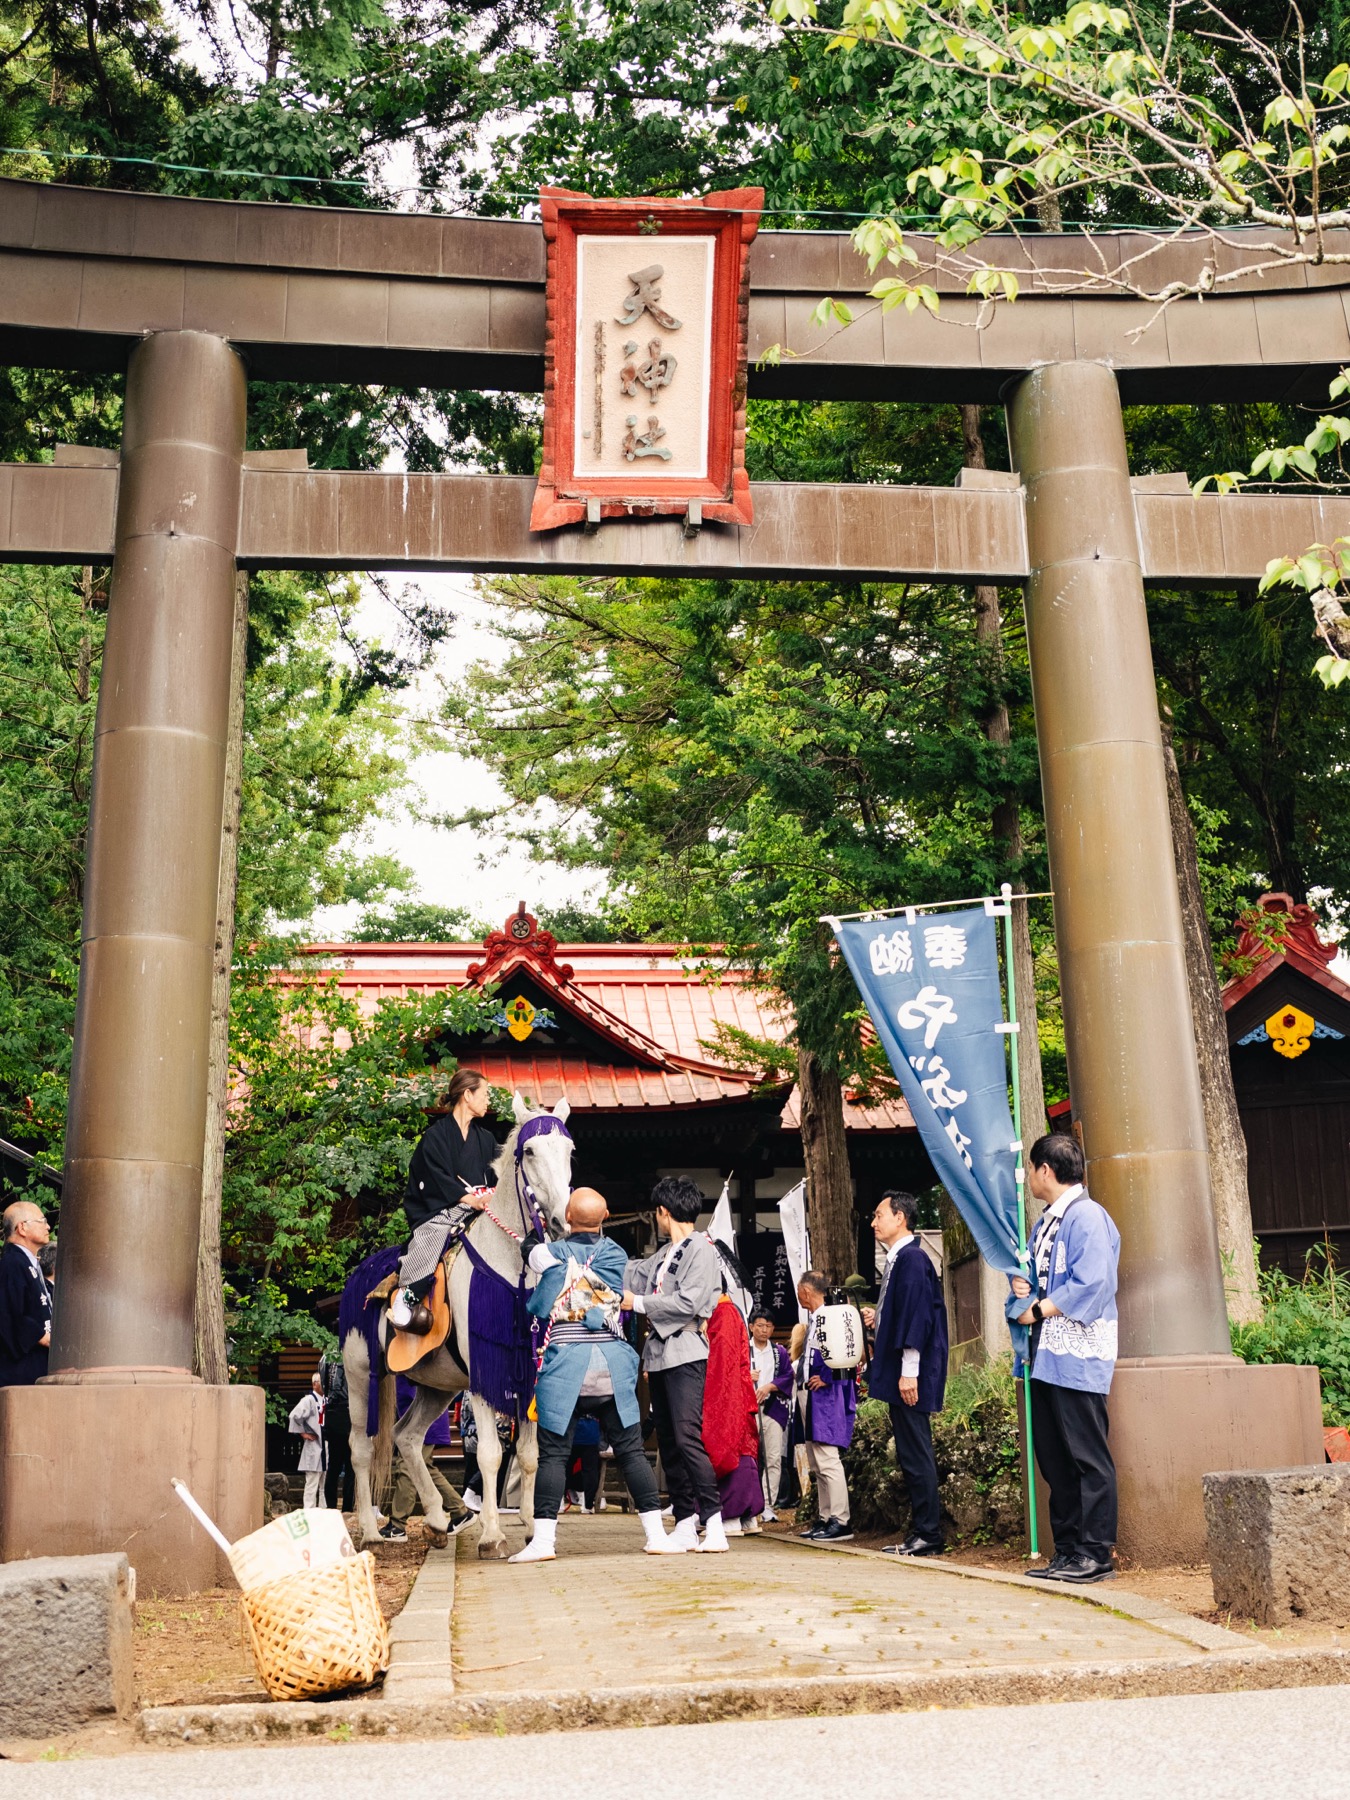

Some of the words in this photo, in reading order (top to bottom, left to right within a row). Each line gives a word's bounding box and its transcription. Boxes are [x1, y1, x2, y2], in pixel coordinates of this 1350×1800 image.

[613, 264, 683, 462] 天神社
[753, 1266, 766, 1312] 正月吉日
[772, 1245, 788, 1309] 昭和六十一年
